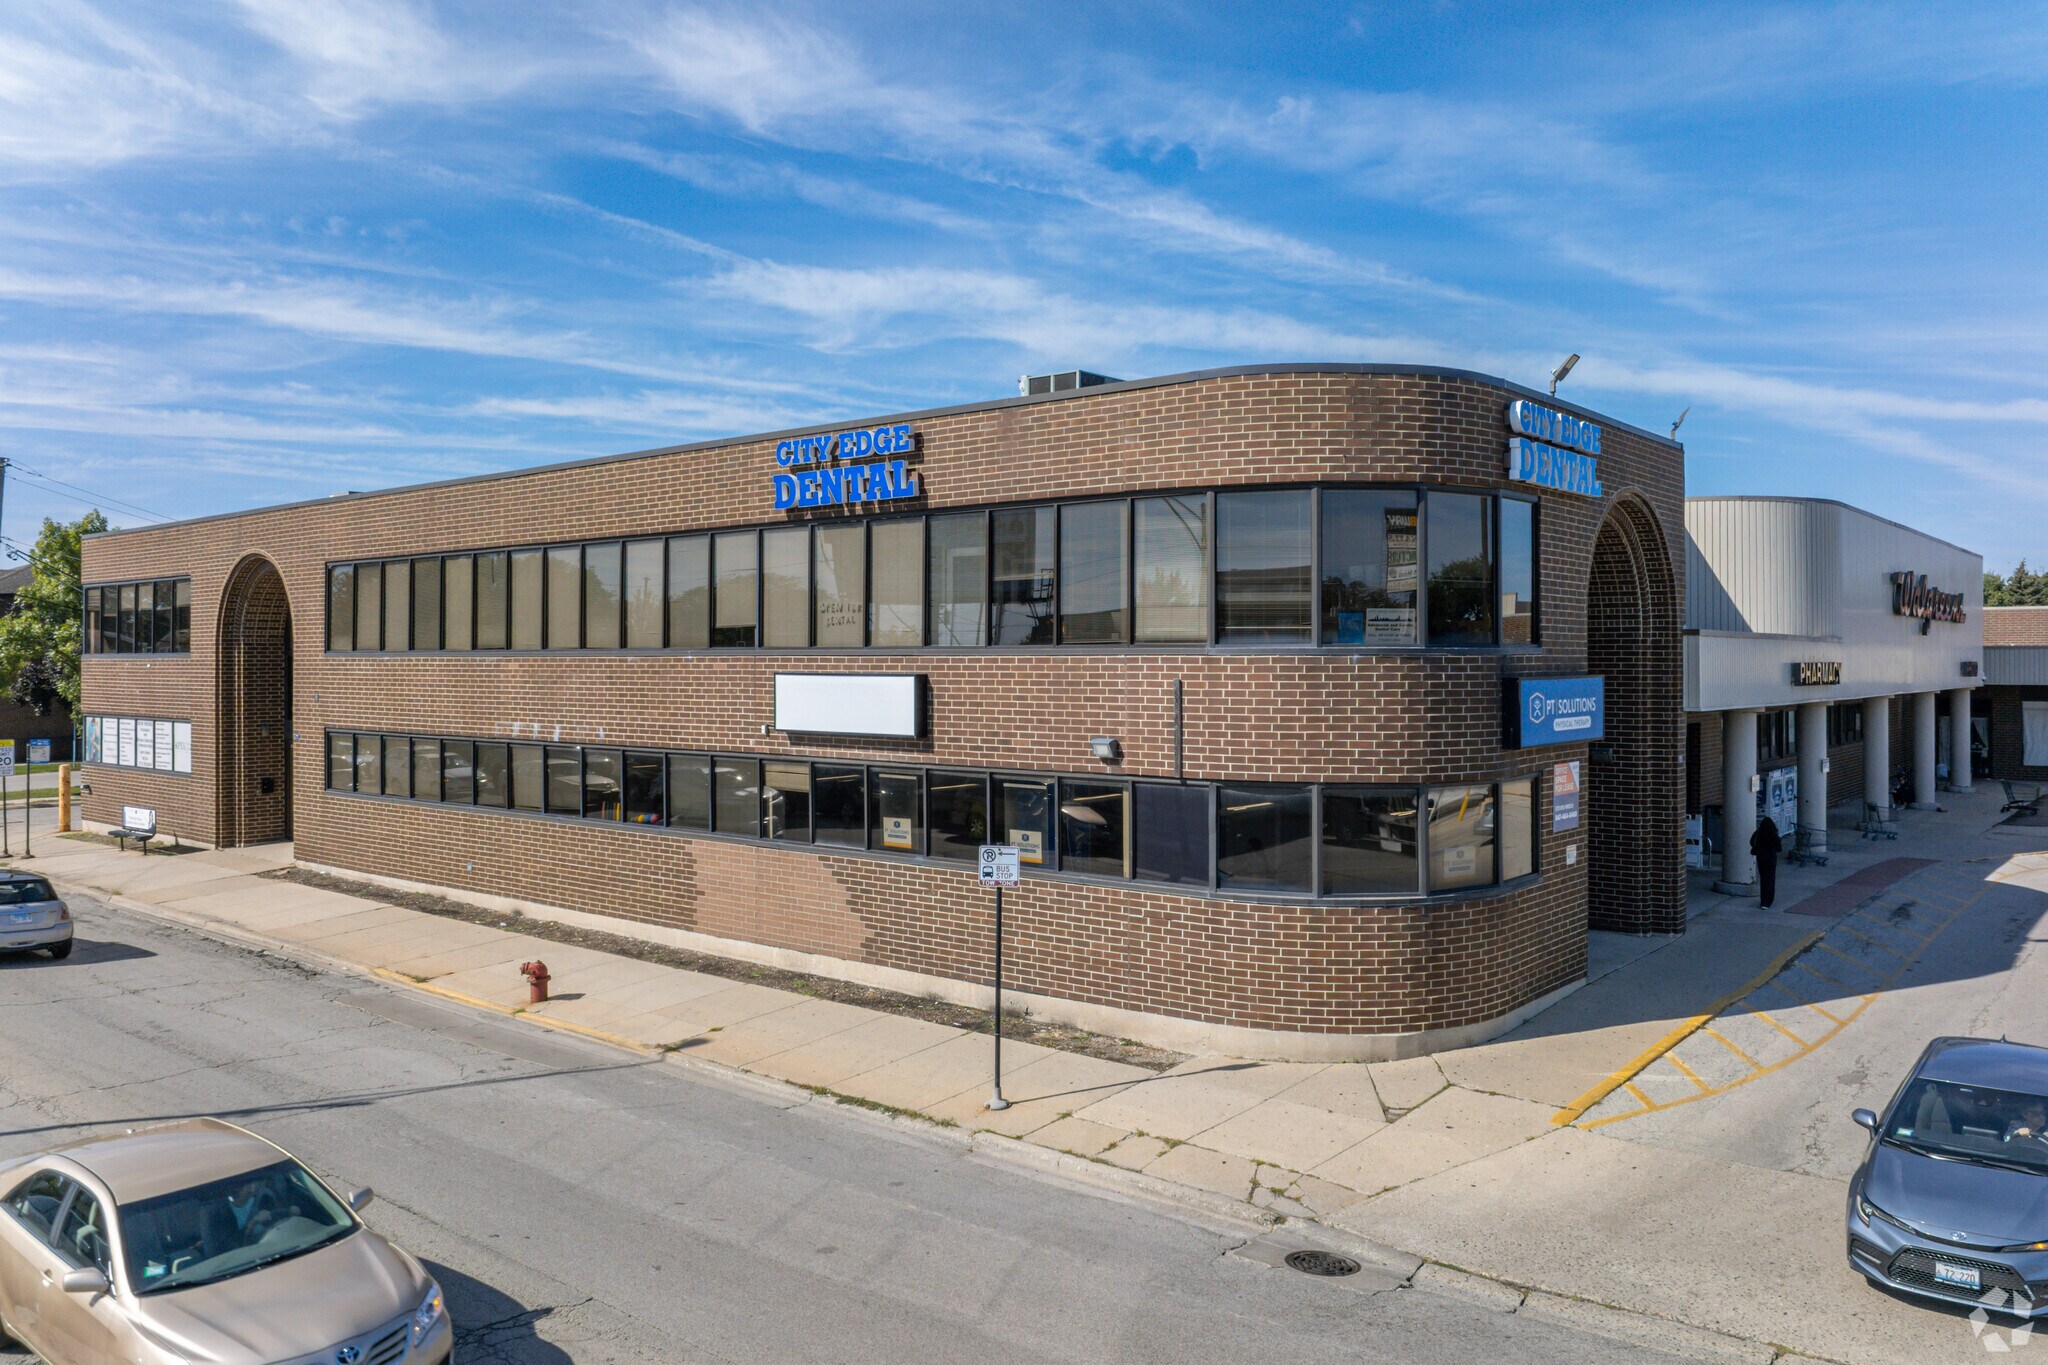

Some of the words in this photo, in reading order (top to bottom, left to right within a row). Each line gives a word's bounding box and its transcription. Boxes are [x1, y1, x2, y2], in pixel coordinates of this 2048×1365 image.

[776, 435, 833, 467] CITY
[838, 424, 912, 459] EDGE
[1518, 400, 1558, 439] CITY
[1560, 413, 1601, 454] EDGE
[773, 460, 916, 510] DENTAL
[1519, 437, 1602, 497] DENTAL
[1800, 661, 1841, 685] PHARMACY
[1546, 699, 1555, 715] PT
[1558, 697, 1596, 714] SOLUTIONS
